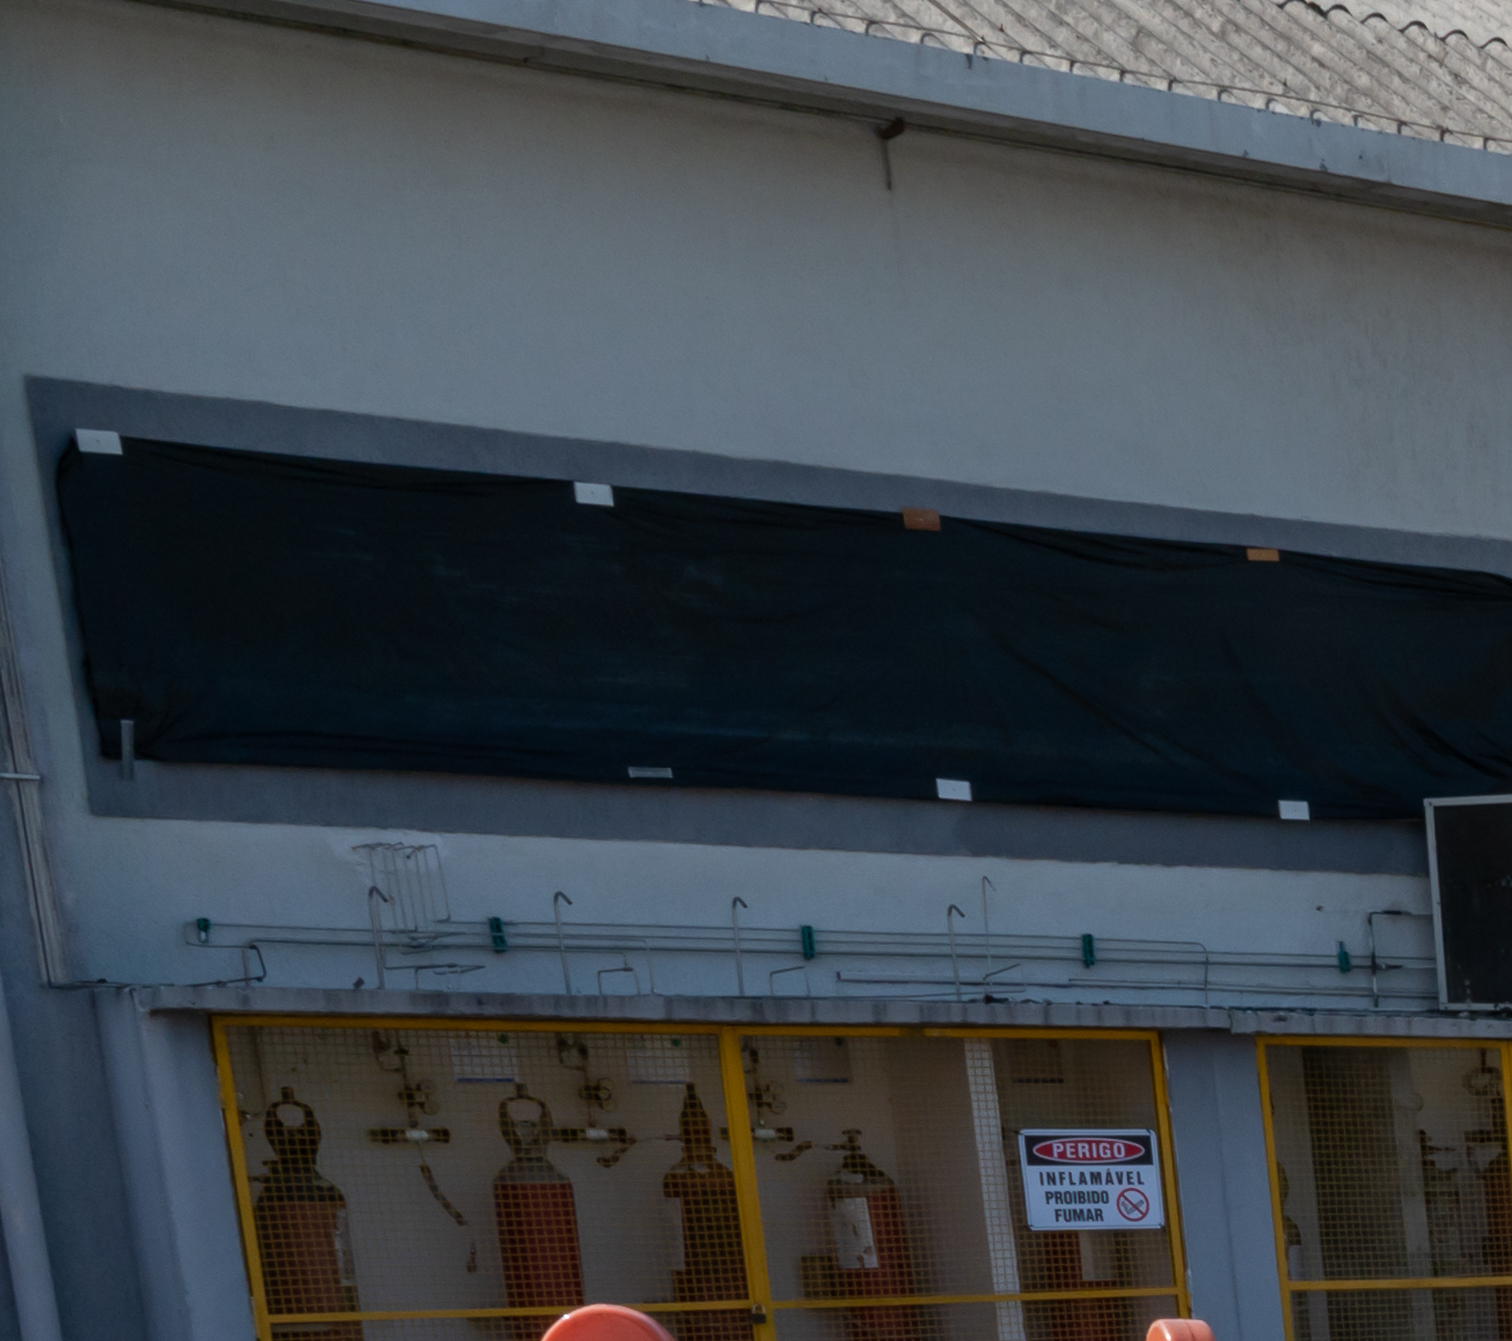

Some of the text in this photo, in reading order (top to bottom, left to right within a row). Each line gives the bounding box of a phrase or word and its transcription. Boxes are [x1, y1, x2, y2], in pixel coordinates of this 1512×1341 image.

[1052, 1142, 1126, 1159] PERIGO
[1039, 1168, 1145, 1186] INFLAMÁVEL
[1045, 1191, 1109, 1205] PROIBIDO
[1055, 1208, 1104, 1222] FUMAR
